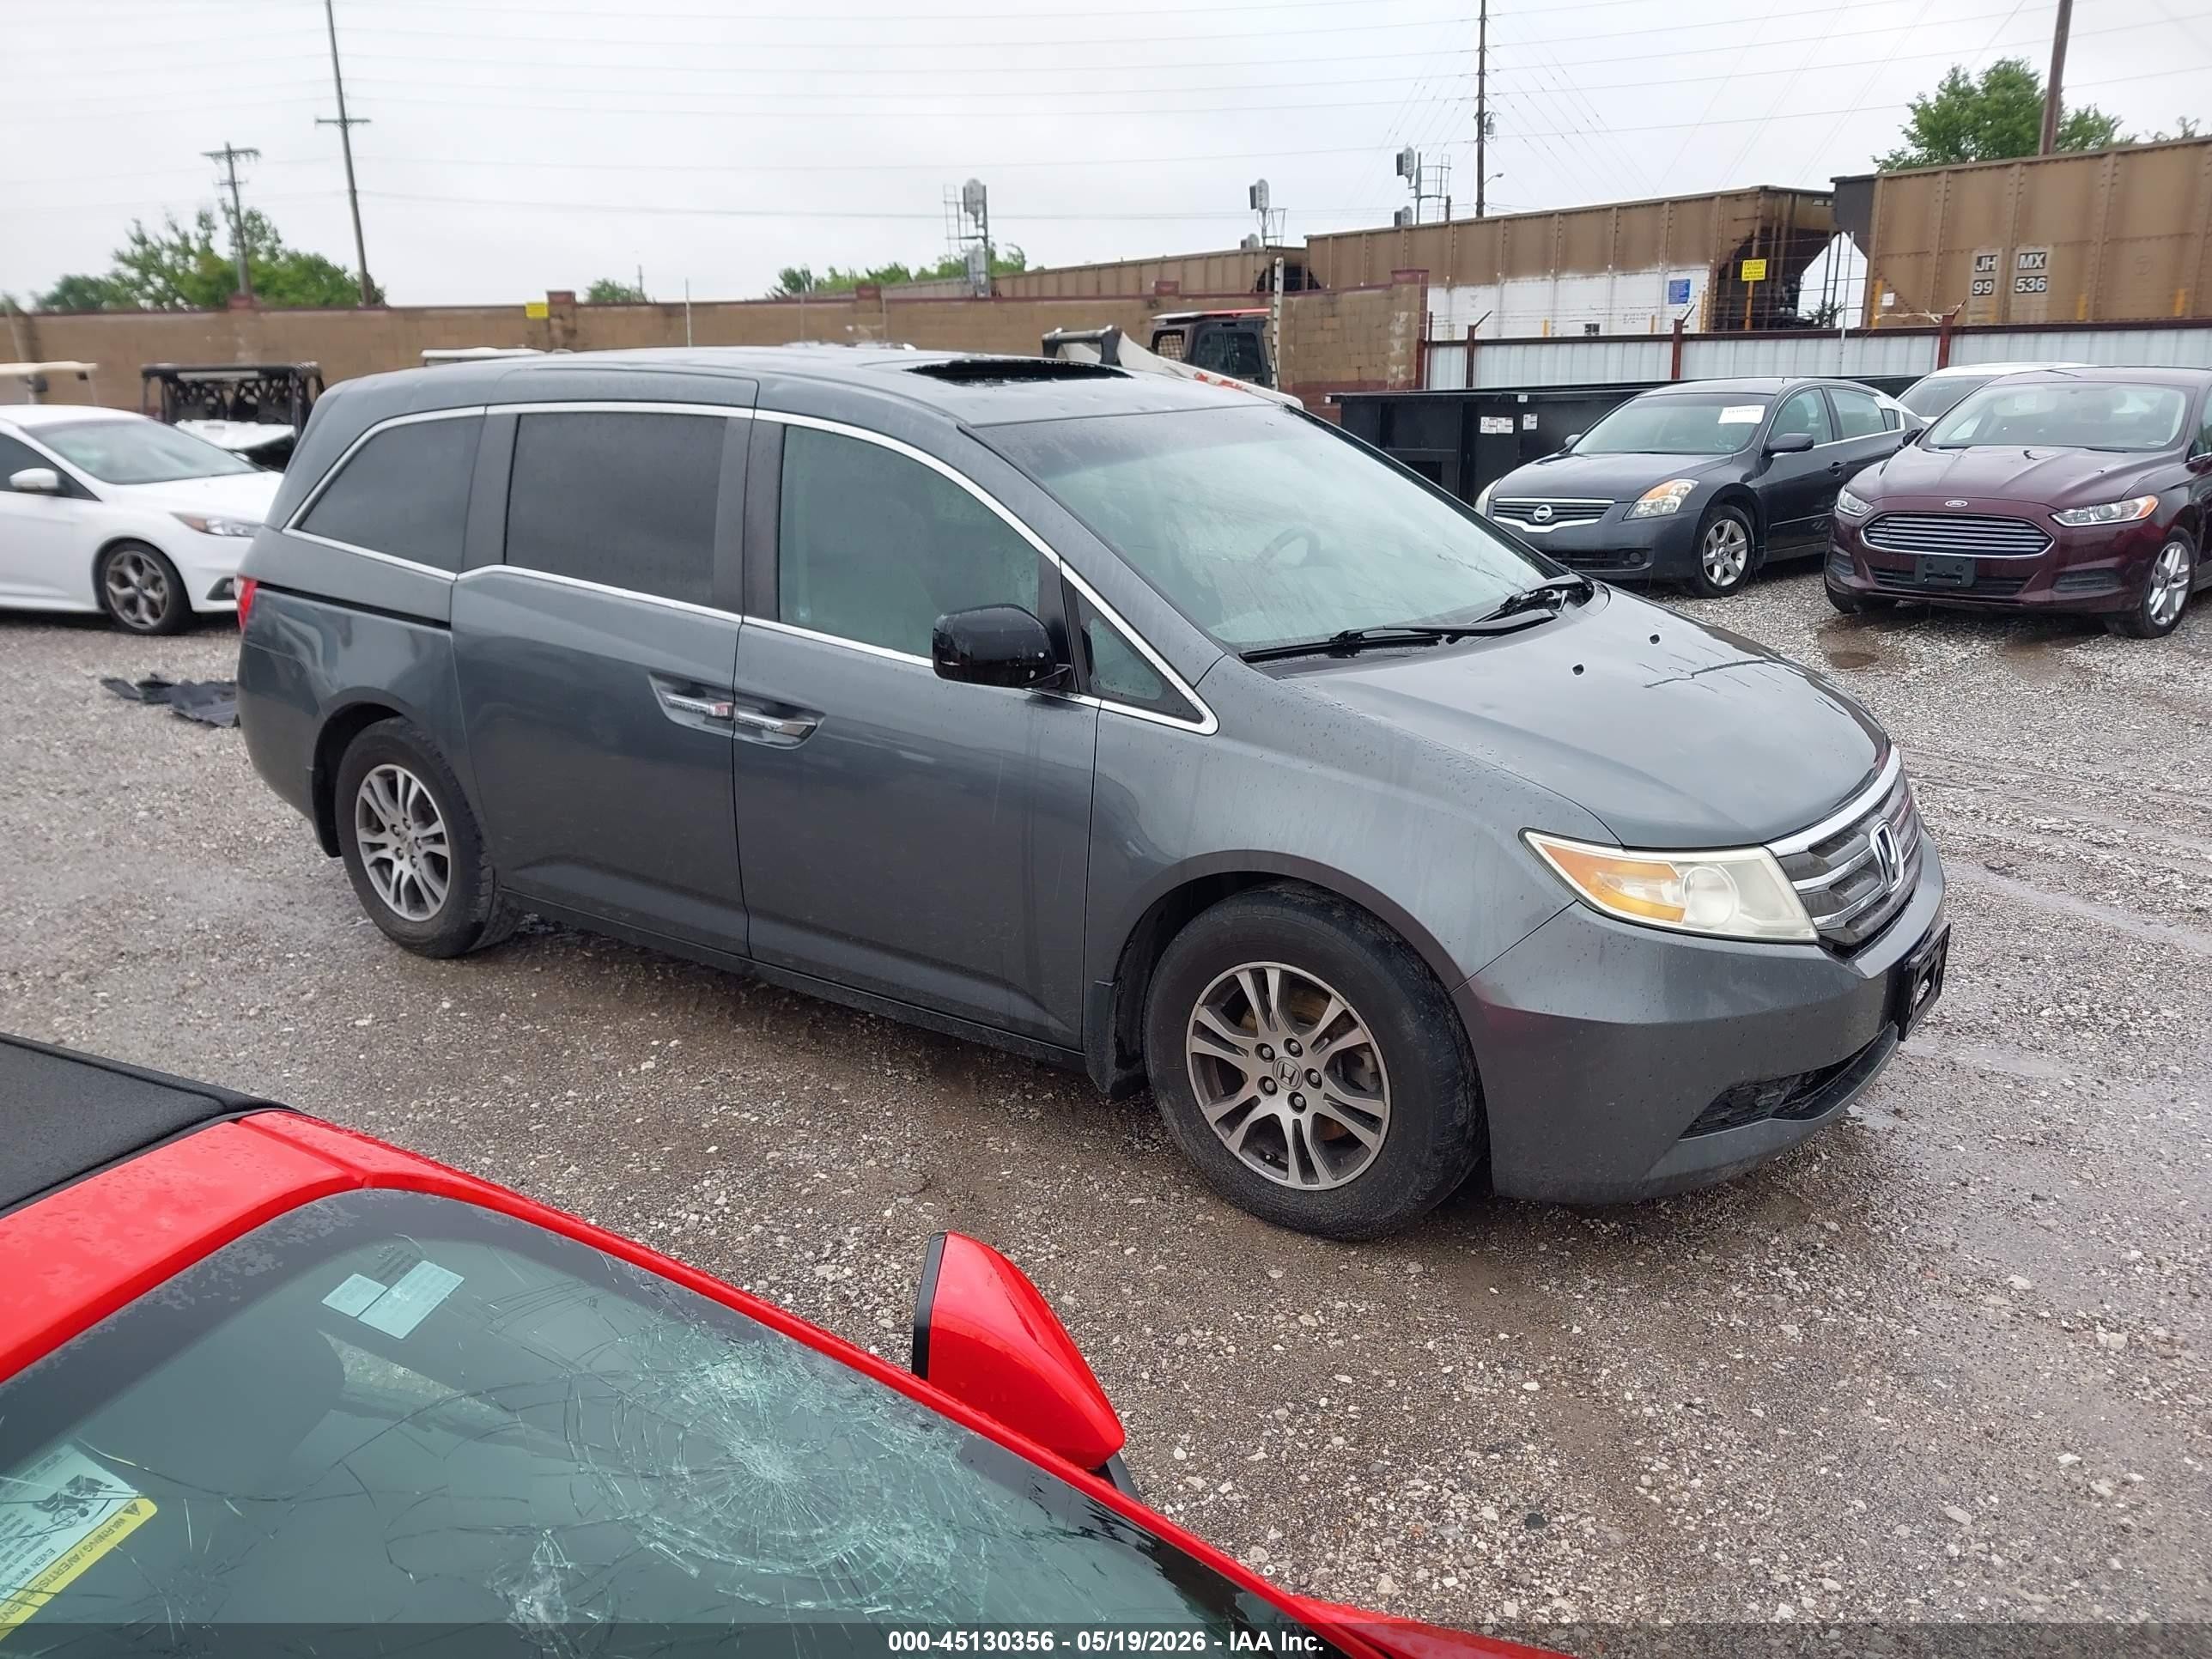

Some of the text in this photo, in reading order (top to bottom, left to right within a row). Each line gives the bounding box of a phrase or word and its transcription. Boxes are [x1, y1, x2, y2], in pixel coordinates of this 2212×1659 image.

[1976, 253, 2045, 271] JH MX
[1972, 277, 2046, 295] 99 536
